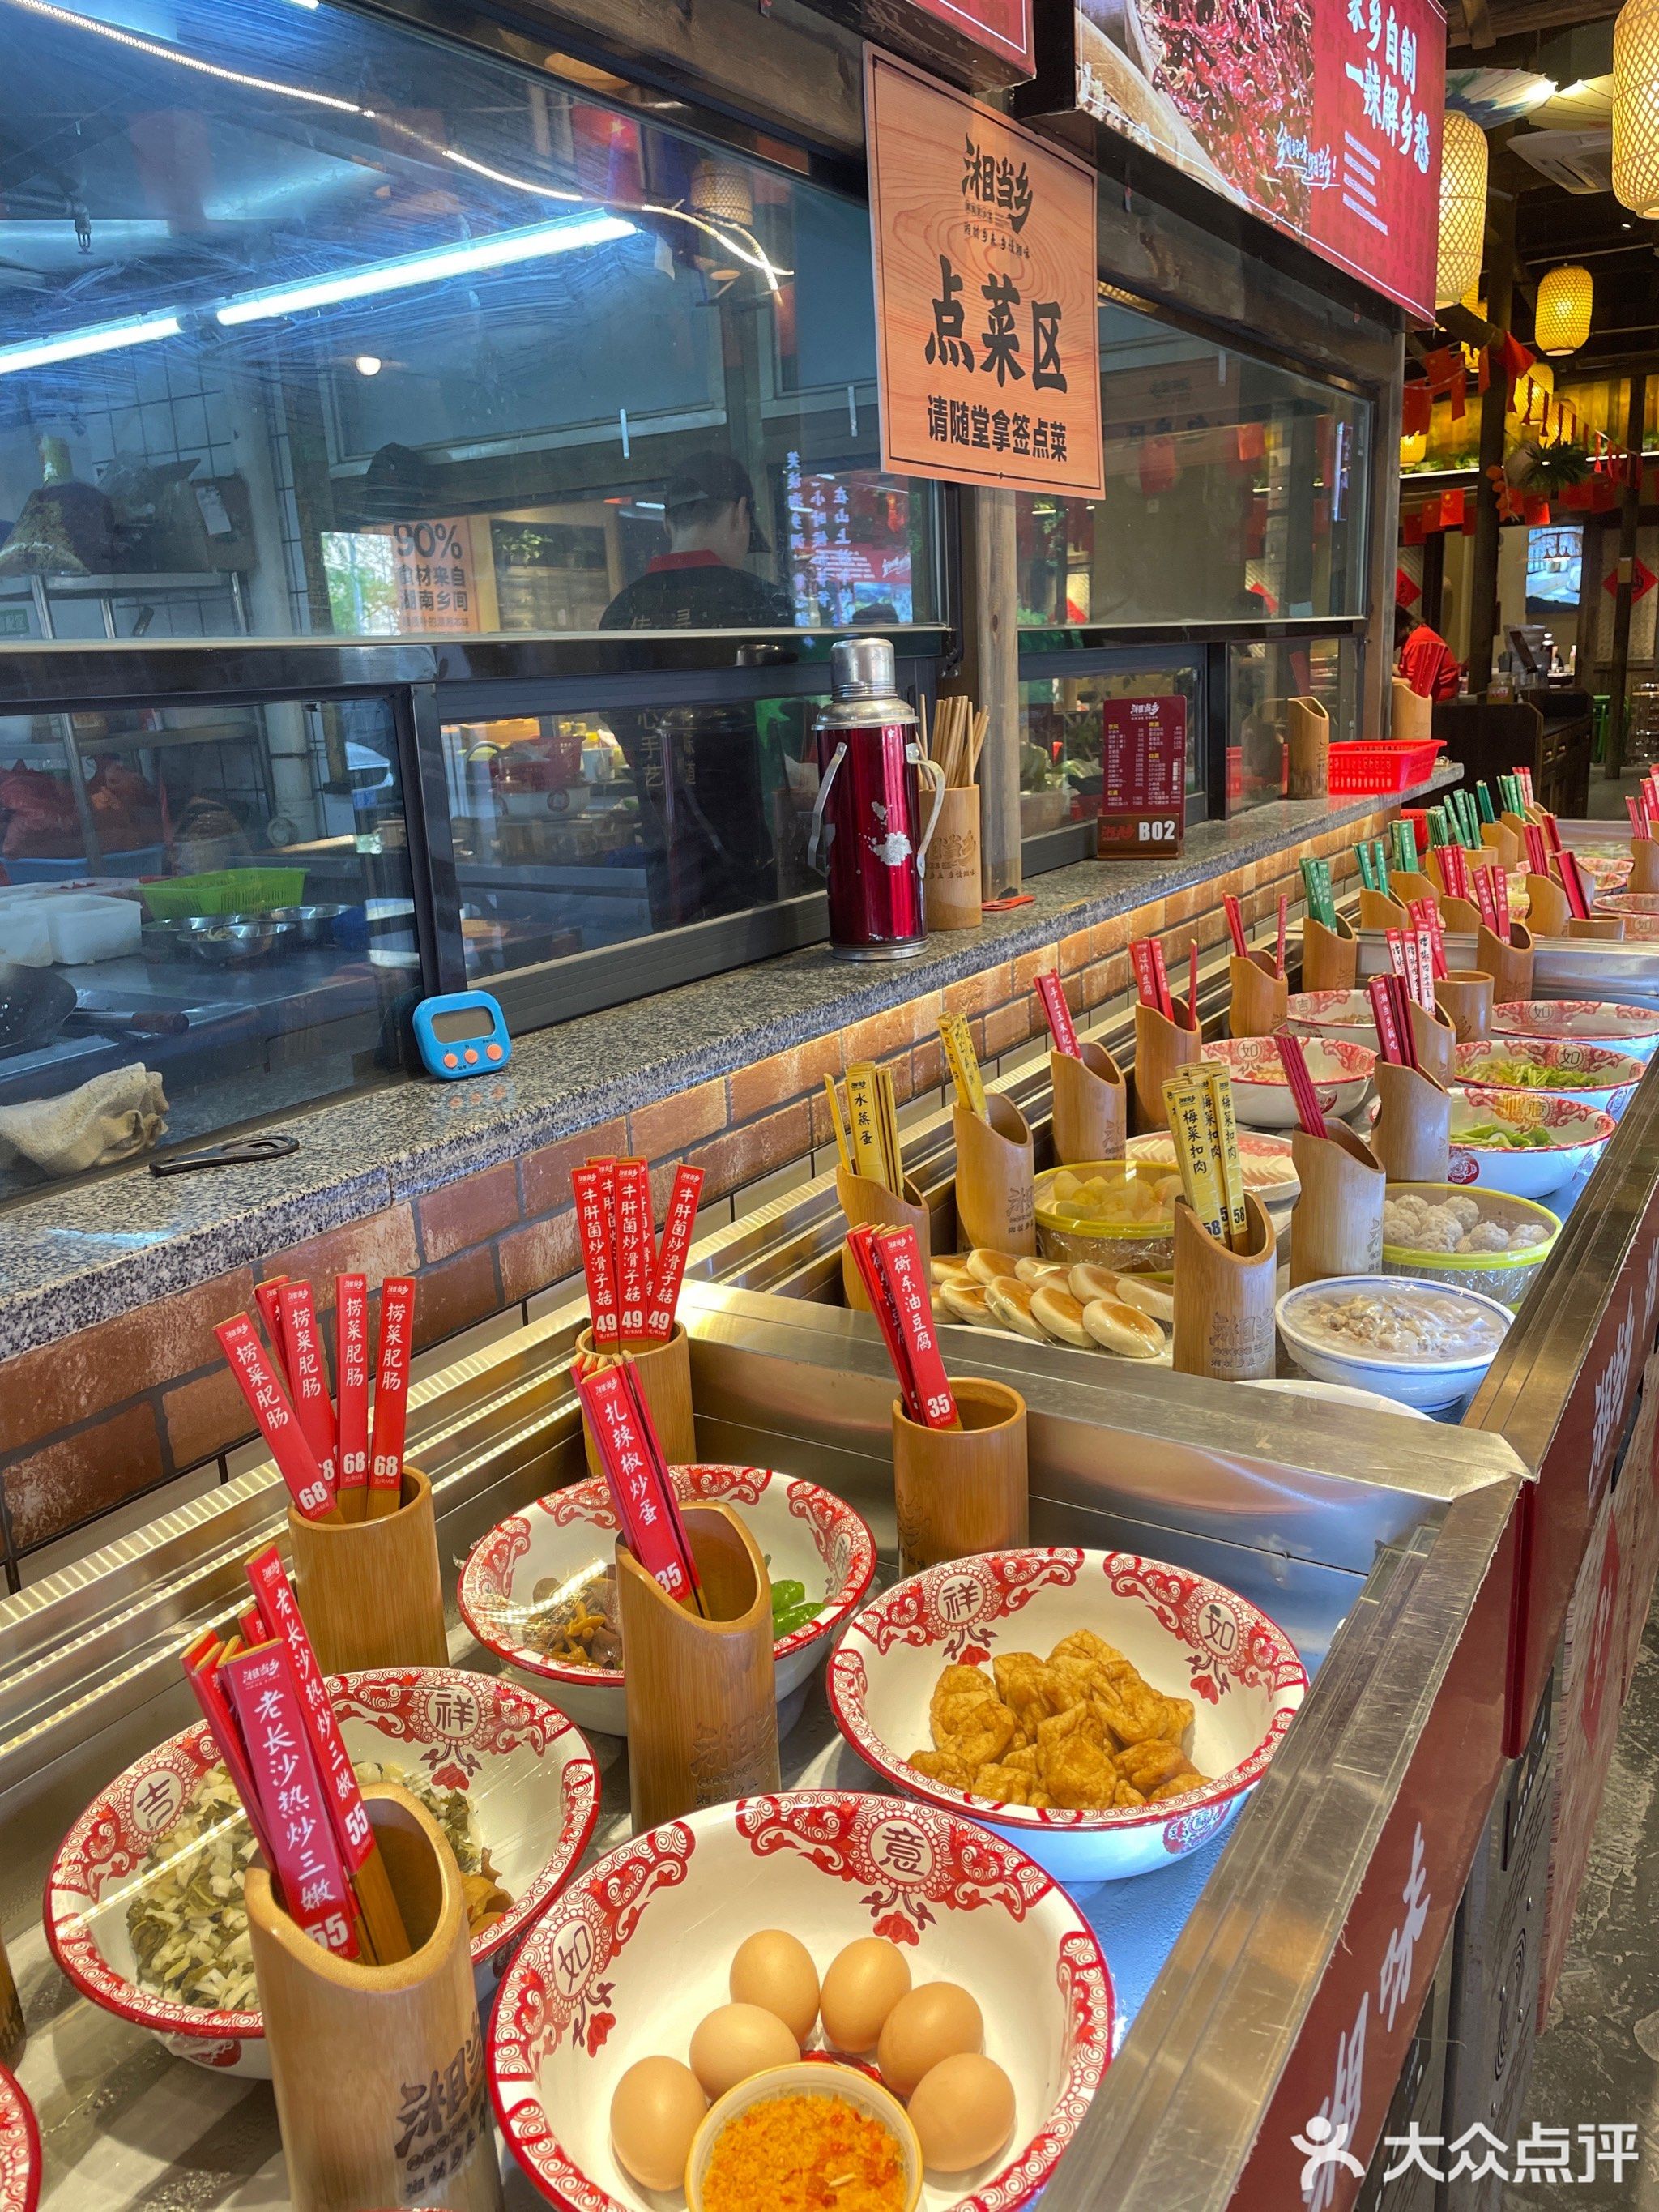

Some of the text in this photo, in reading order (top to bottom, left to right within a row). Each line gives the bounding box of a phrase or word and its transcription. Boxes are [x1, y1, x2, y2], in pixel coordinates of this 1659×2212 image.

[1346, 57, 1430, 173] 一辣解乡愁
[962, 132, 1034, 234] 湘当乡
[925, 254, 1068, 395] 点菜区
[928, 394, 1068, 463] 请随堂拿签点菜
[392, 522, 463, 560] 90%
[397, 564, 467, 588] 食材来自
[399, 589, 469, 613] 湖南乡间
[1139, 820, 1175, 841] B02
[1533, 1006, 1550, 1018] 如
[1240, 1043, 1259, 1057] 如
[1560, 1050, 1580, 1065] 如
[854, 1092, 873, 1145] 水蒸蛋
[1183, 1108, 1207, 1175] 梅菜扣肉
[1221, 1094, 1238, 1161] 梅菜扣肉
[1233, 1206, 1245, 1223] 58
[582, 1188, 613, 1307] 牛肝菌炒滑子菇
[621, 1183, 641, 1303] 牛肝菌炒滑子菇
[656, 1187, 695, 1305] 牛肝菌炒滑子菇
[596, 1313, 618, 1333] 49
[621, 1310, 643, 1330] 49
[647, 1309, 670, 1330] 49
[894, 1254, 932, 1351] 衡东油豆腐
[292, 1307, 322, 1399] 捞菜肥肠
[345, 1297, 365, 1387] 捞菜肥肠
[381, 1302, 406, 1391] 捞菜肥肠
[236, 1342, 288, 1431] 捞菜肥肠
[927, 1393, 951, 1418] 35
[318, 1458, 335, 1480] 8
[343, 1451, 365, 1474] 68
[373, 1455, 398, 1477] 68
[604, 1399, 658, 1526] 扎辣椒炒蛋
[298, 1480, 329, 1510] 68
[655, 1561, 683, 1594] 35
[942, 1578, 981, 1619] 祥
[275, 1588, 355, 1800] 老长沙热炒三嫩
[435, 1693, 476, 1732] 祥
[254, 1689, 336, 1913] 老长沙热炒三嫩
[344, 1800, 369, 1847] 55
[882, 1826, 926, 1877] 意
[305, 1912, 349, 1949] 55
[557, 1928, 594, 1993] 如
